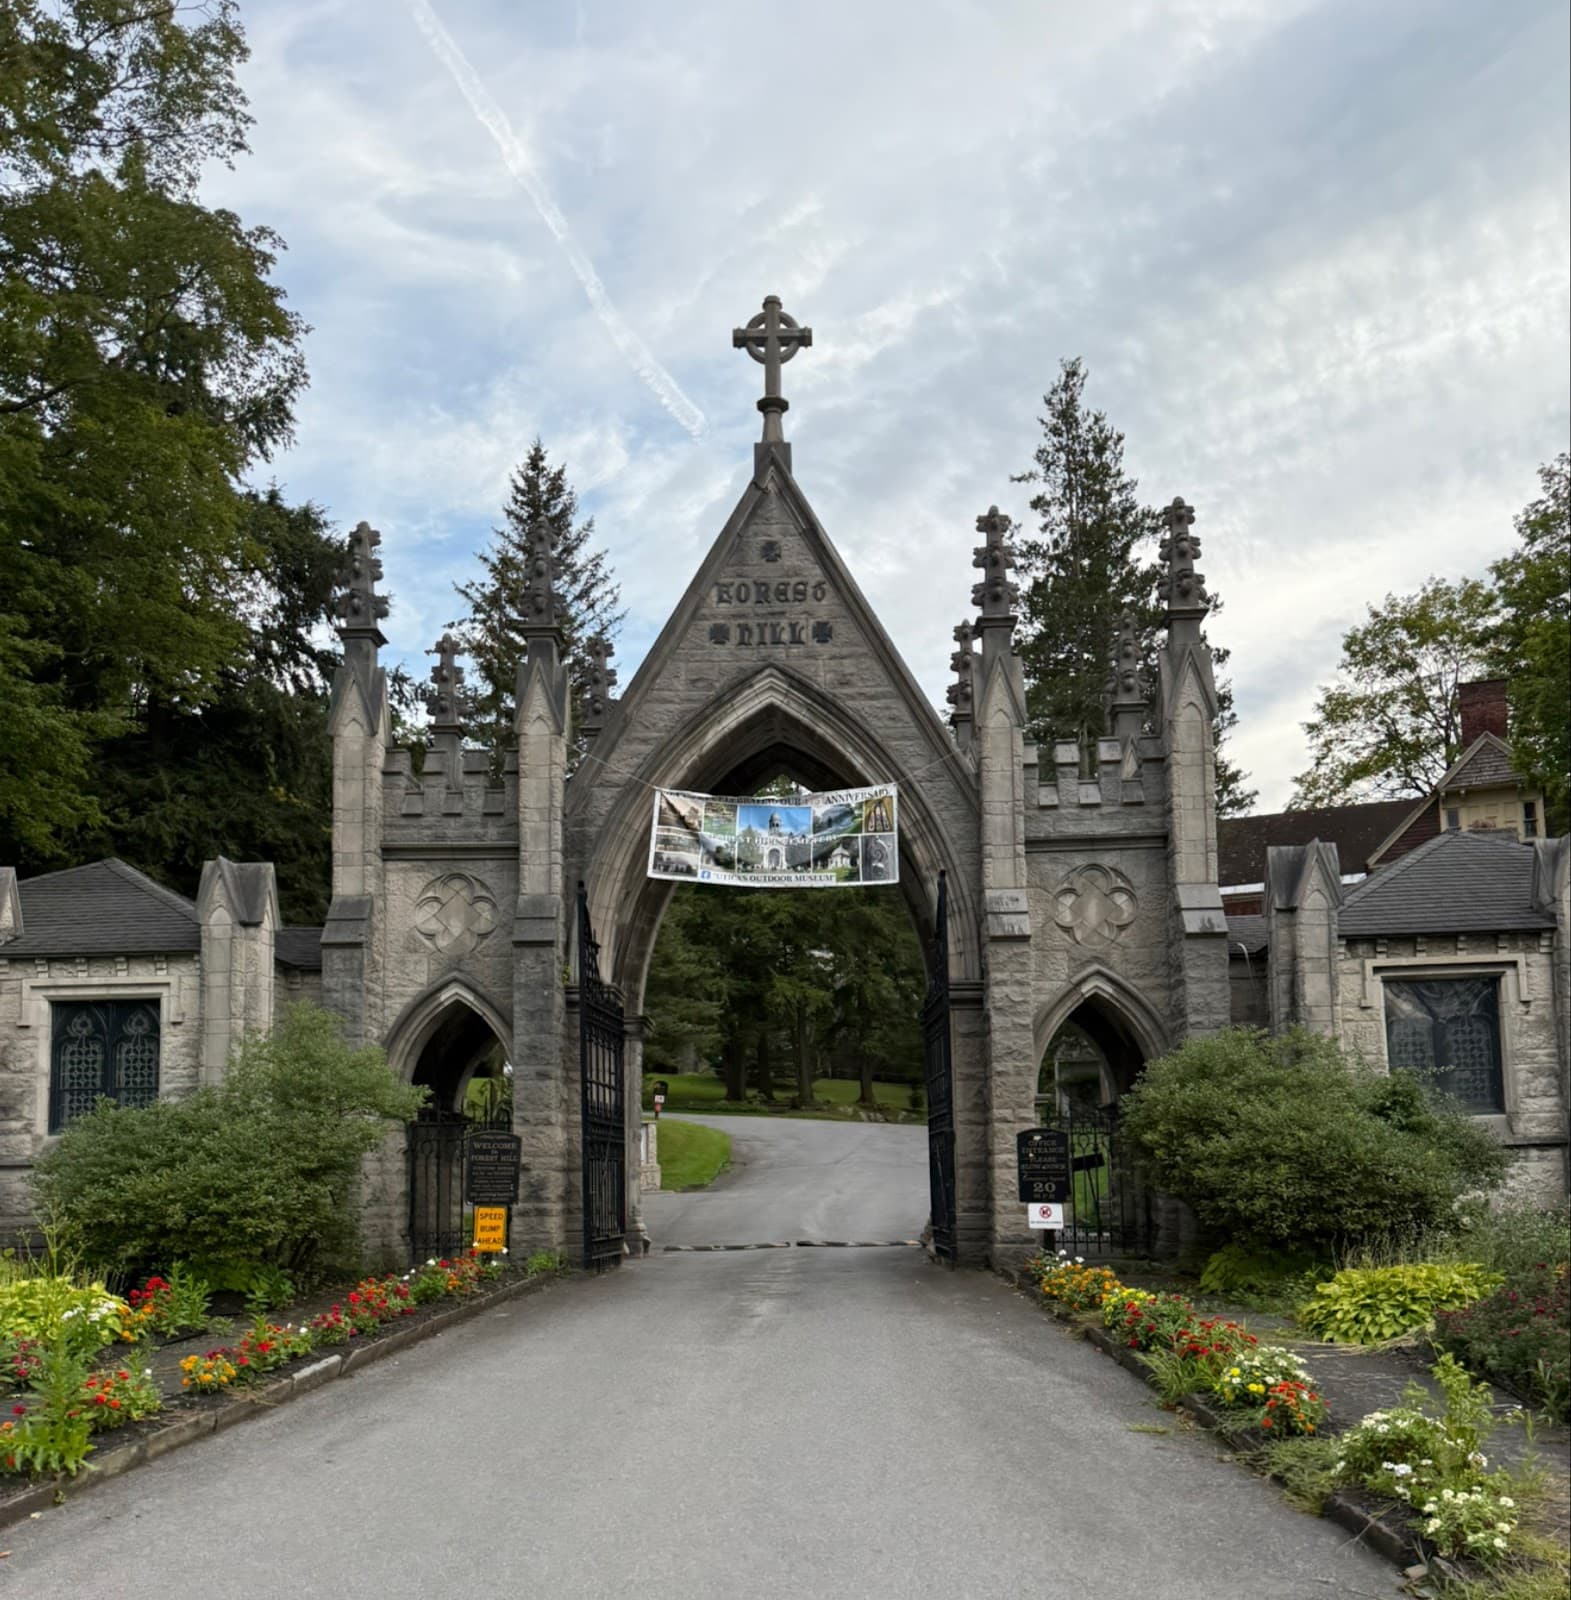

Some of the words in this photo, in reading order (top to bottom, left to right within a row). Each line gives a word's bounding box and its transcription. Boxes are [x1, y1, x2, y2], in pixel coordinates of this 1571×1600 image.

[736, 622, 805, 646] HILL
[824, 788, 890, 805] ANNIVERSARY
[749, 874, 792, 883] OUTDOOR
[1033, 1182, 1056, 1192] 20
